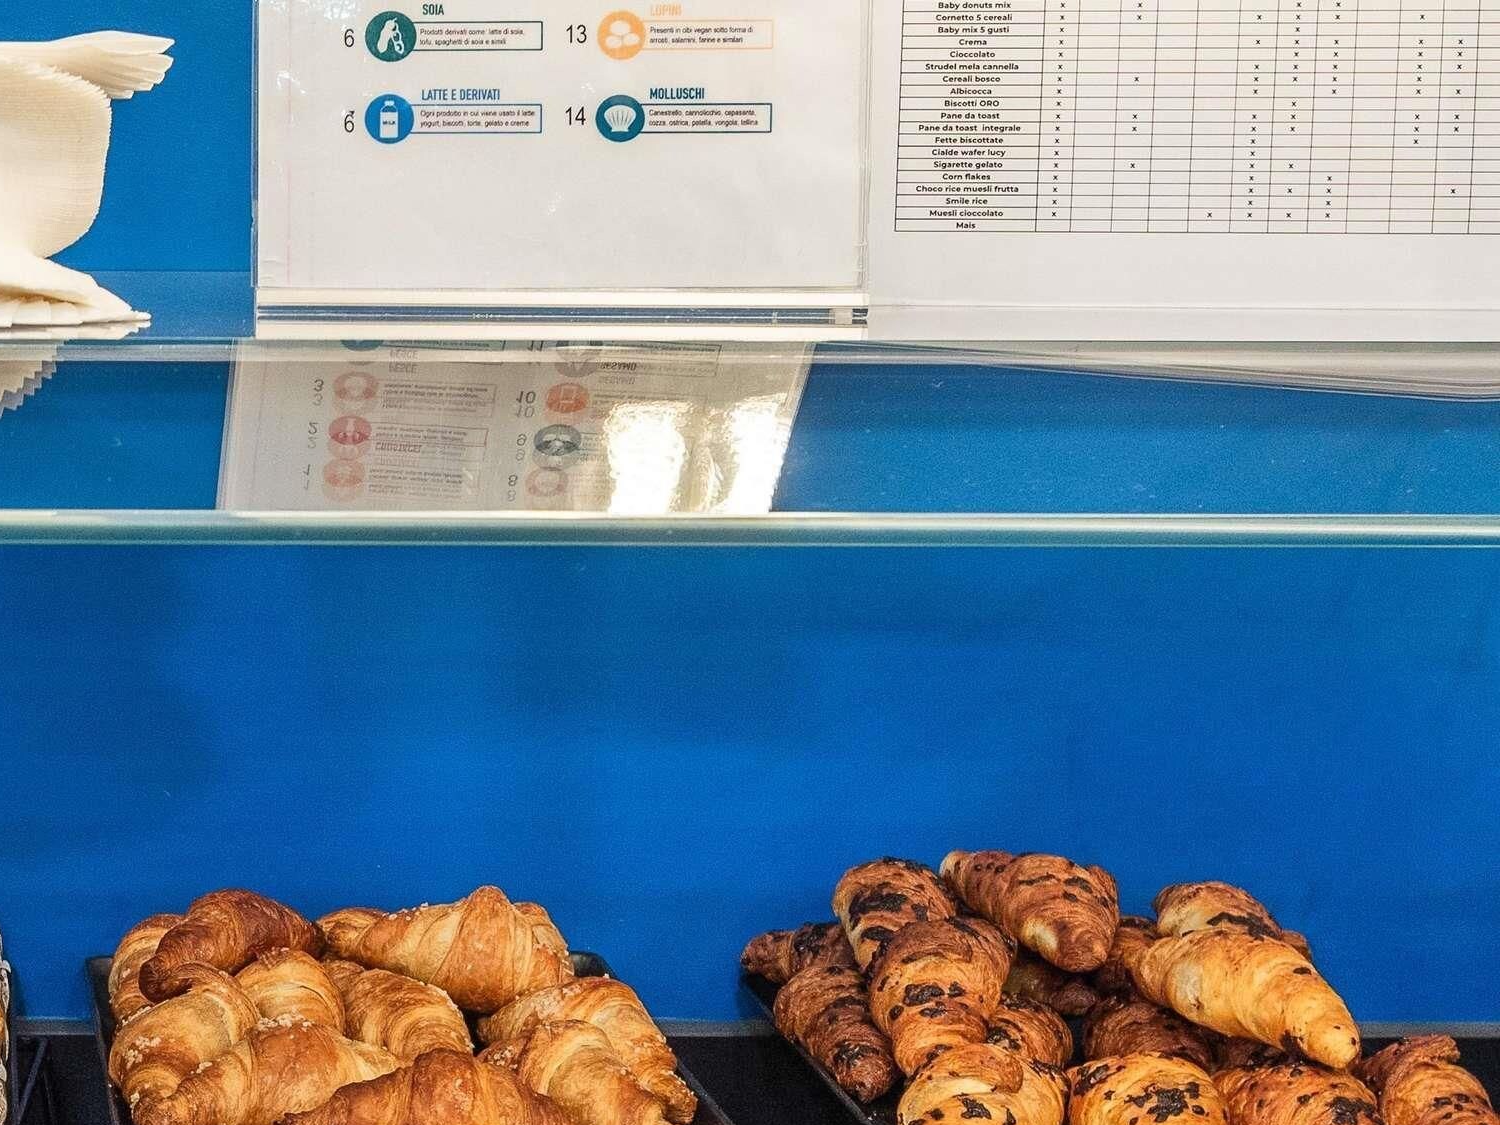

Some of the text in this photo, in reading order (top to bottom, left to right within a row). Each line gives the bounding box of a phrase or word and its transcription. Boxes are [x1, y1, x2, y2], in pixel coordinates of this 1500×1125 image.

[422, 4, 444, 15] SOIA
[938, 1, 1012, 11] Baby donuts mix
[935, 13, 1013, 22] Cornetto 5 cereali
[566, 24, 587, 44] 13
[694, 27, 712, 35] vegan
[938, 26, 960, 35] Baby
[962, 26, 978, 34] mix
[987, 26, 1010, 35] gusti
[344, 28, 355, 48] 6
[958, 38, 987, 46] Crema
[949, 50, 996, 58] Cioccolato
[925, 63, 957, 71] Strudel
[942, 75, 1001, 83] Cereali bosco
[421, 88, 500, 100] LATTE E DERIVATI
[650, 87, 704, 100] MOLLUSCHI
[950, 87, 992, 95] Albicocca
[944, 99, 977, 107] Biscotti
[436, 110, 461, 118] prodotto
[565, 106, 586, 126] 14
[940, 112, 963, 120] Pane
[964, 112, 976, 120] da
[918, 124, 941, 132] Pane
[942, 124, 953, 132] da
[982, 124, 1021, 133] integrale
[931, 148, 1006, 158] Cialde wafer lucy
[933, 160, 1003, 170] Sigarette gelato
[945, 185, 961, 193] rice
[963, 185, 992, 193] muesli
[994, 185, 1019, 193] frutta
[945, 197, 988, 205] Smile rice
[929, 209, 1004, 217] Muesli cioccolato
